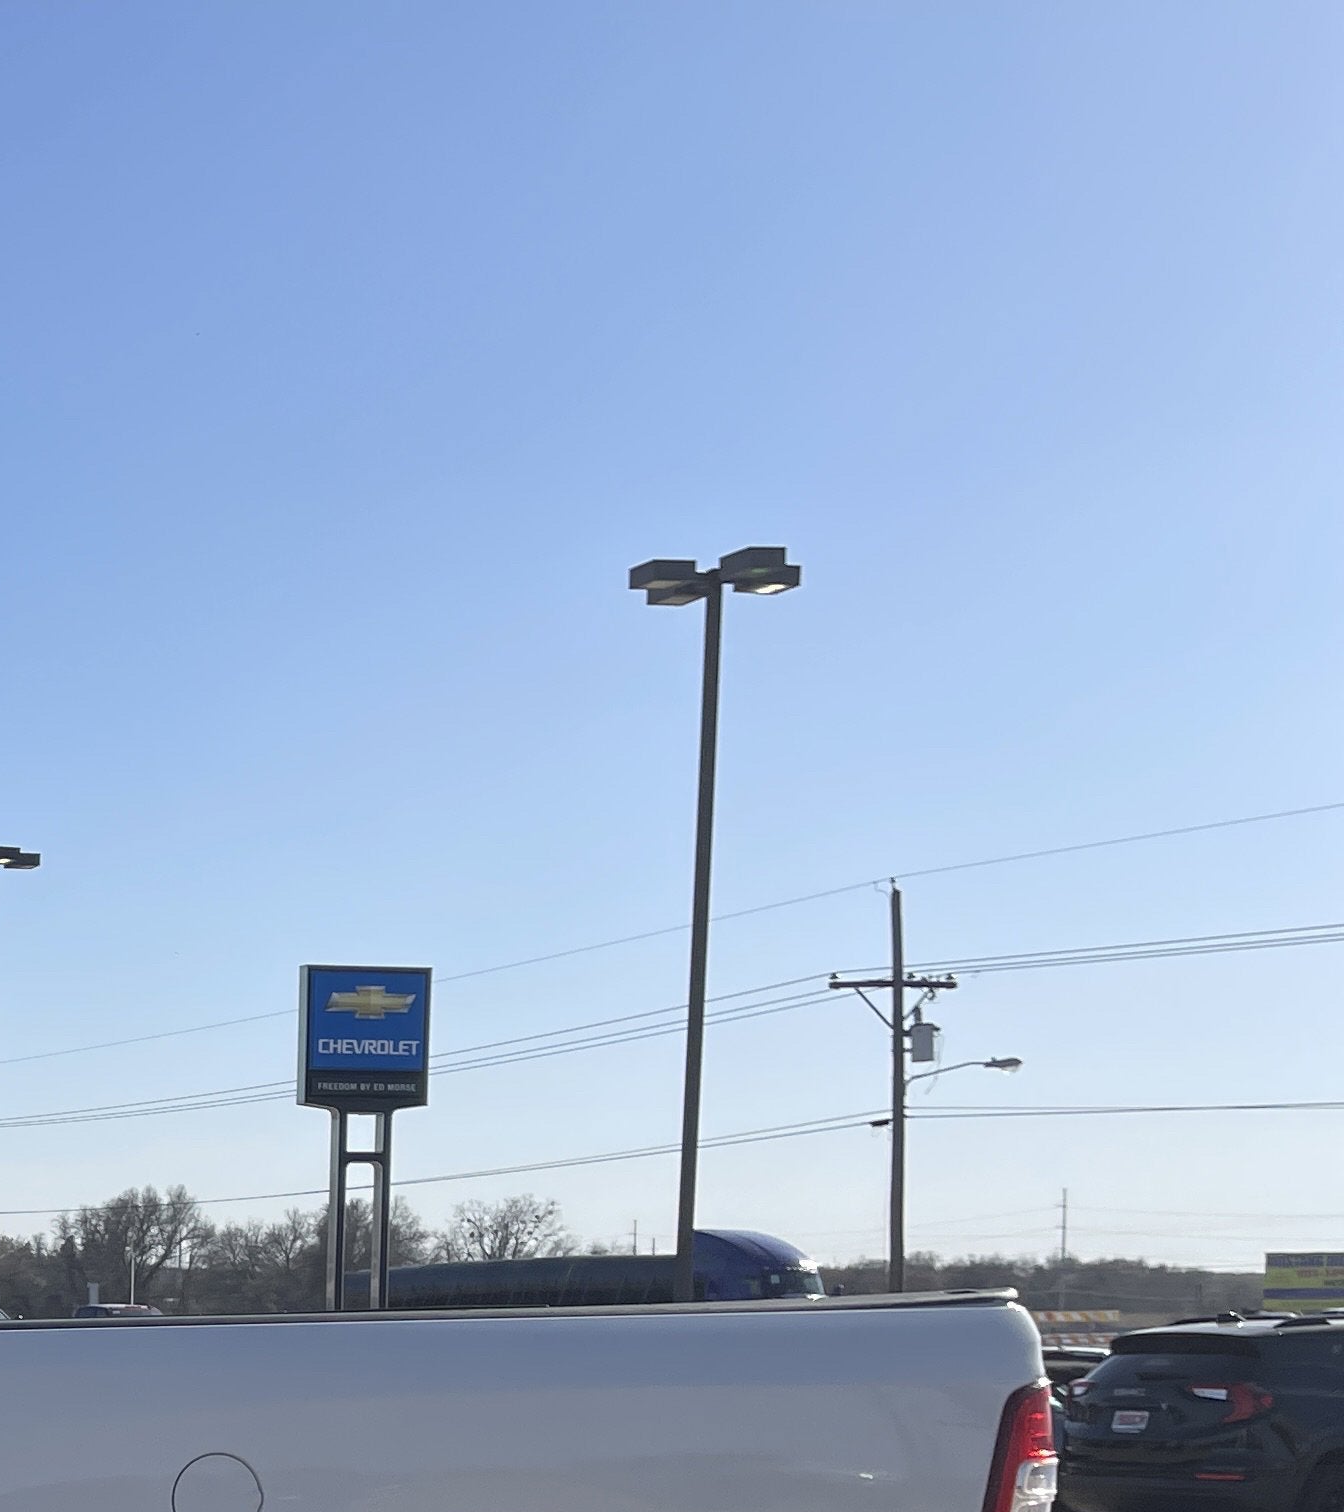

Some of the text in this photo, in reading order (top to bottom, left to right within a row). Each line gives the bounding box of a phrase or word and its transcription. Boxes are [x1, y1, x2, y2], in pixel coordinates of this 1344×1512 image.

[318, 1039, 420, 1056] CHEVROLET
[317, 1082, 357, 1091] FREEDOM
[360, 1083, 371, 1091] BY
[373, 1083, 385, 1091] ED
